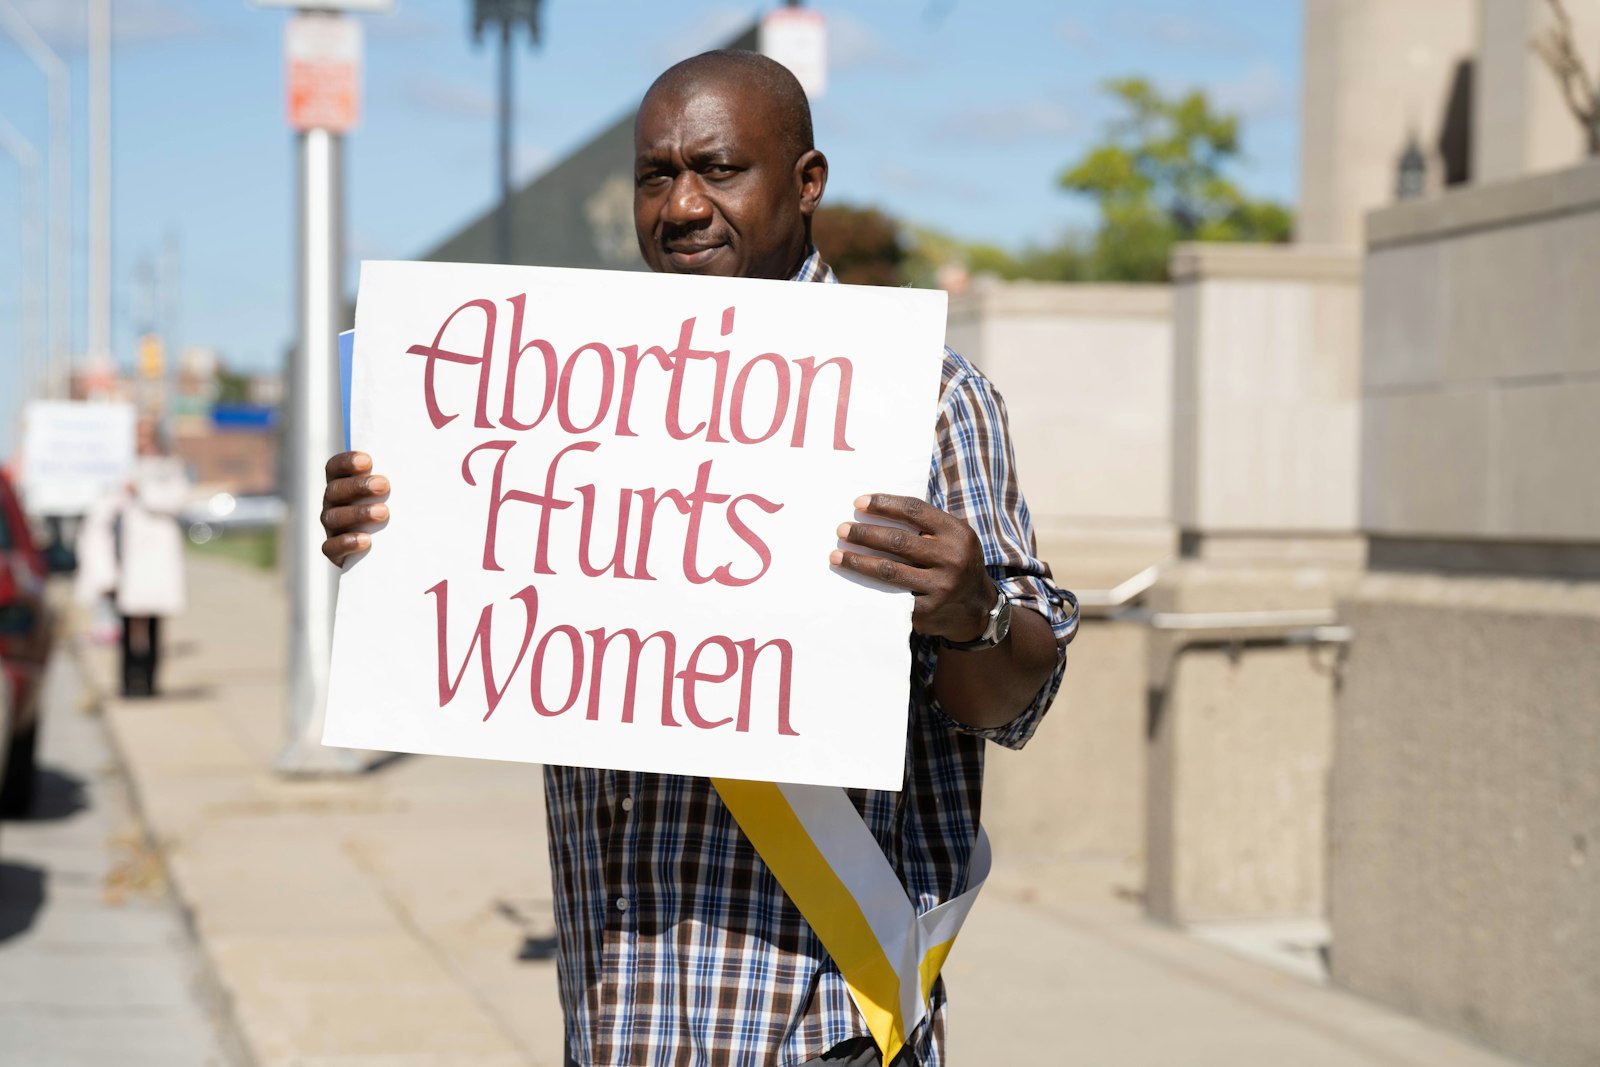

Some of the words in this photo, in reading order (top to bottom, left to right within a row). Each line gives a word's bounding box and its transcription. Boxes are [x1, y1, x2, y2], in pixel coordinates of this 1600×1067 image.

[408, 293, 855, 451] Abortion
[461, 440, 784, 587] Hurts
[425, 579, 800, 736] Women
